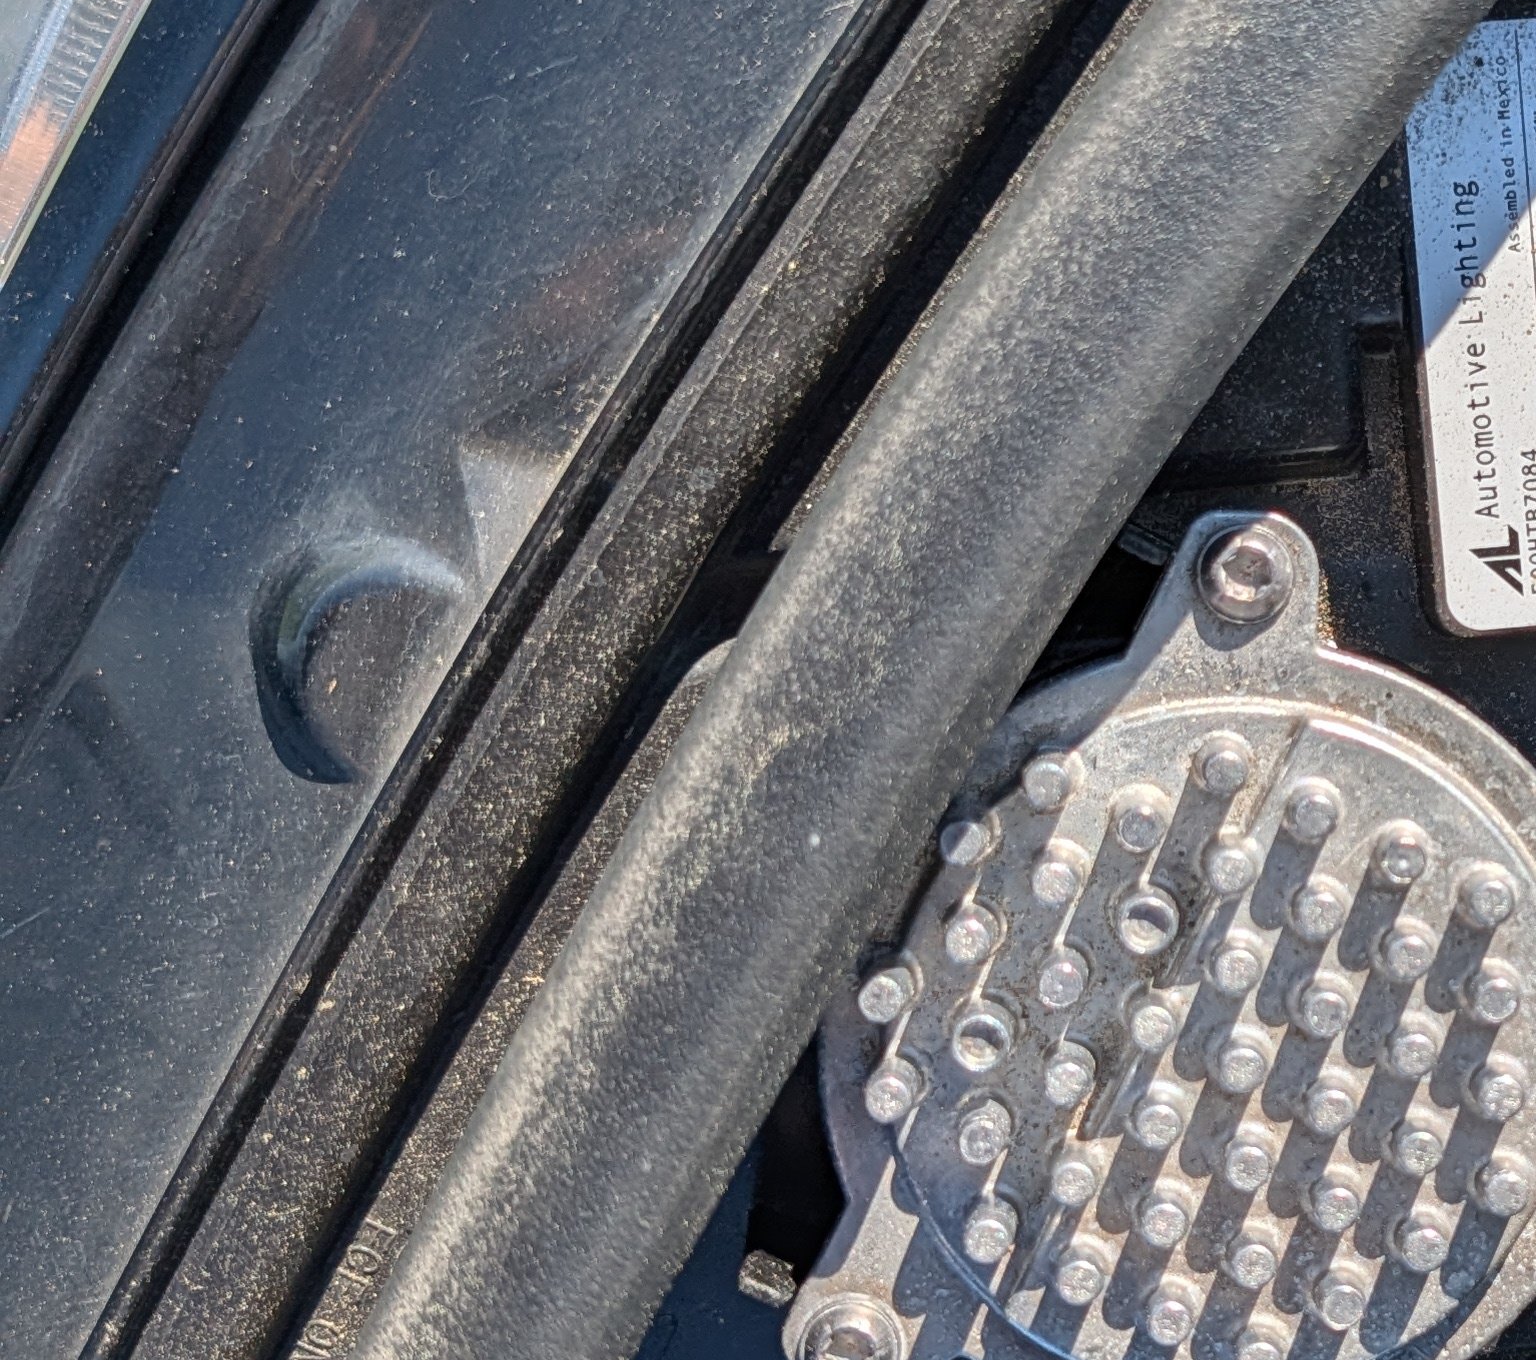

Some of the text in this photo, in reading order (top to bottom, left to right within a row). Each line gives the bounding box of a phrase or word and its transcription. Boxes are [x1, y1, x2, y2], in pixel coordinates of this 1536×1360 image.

[1497, 55, 1522, 254] Assembled in Mexico
[1450, 179, 1500, 520] Automotive Lighting
